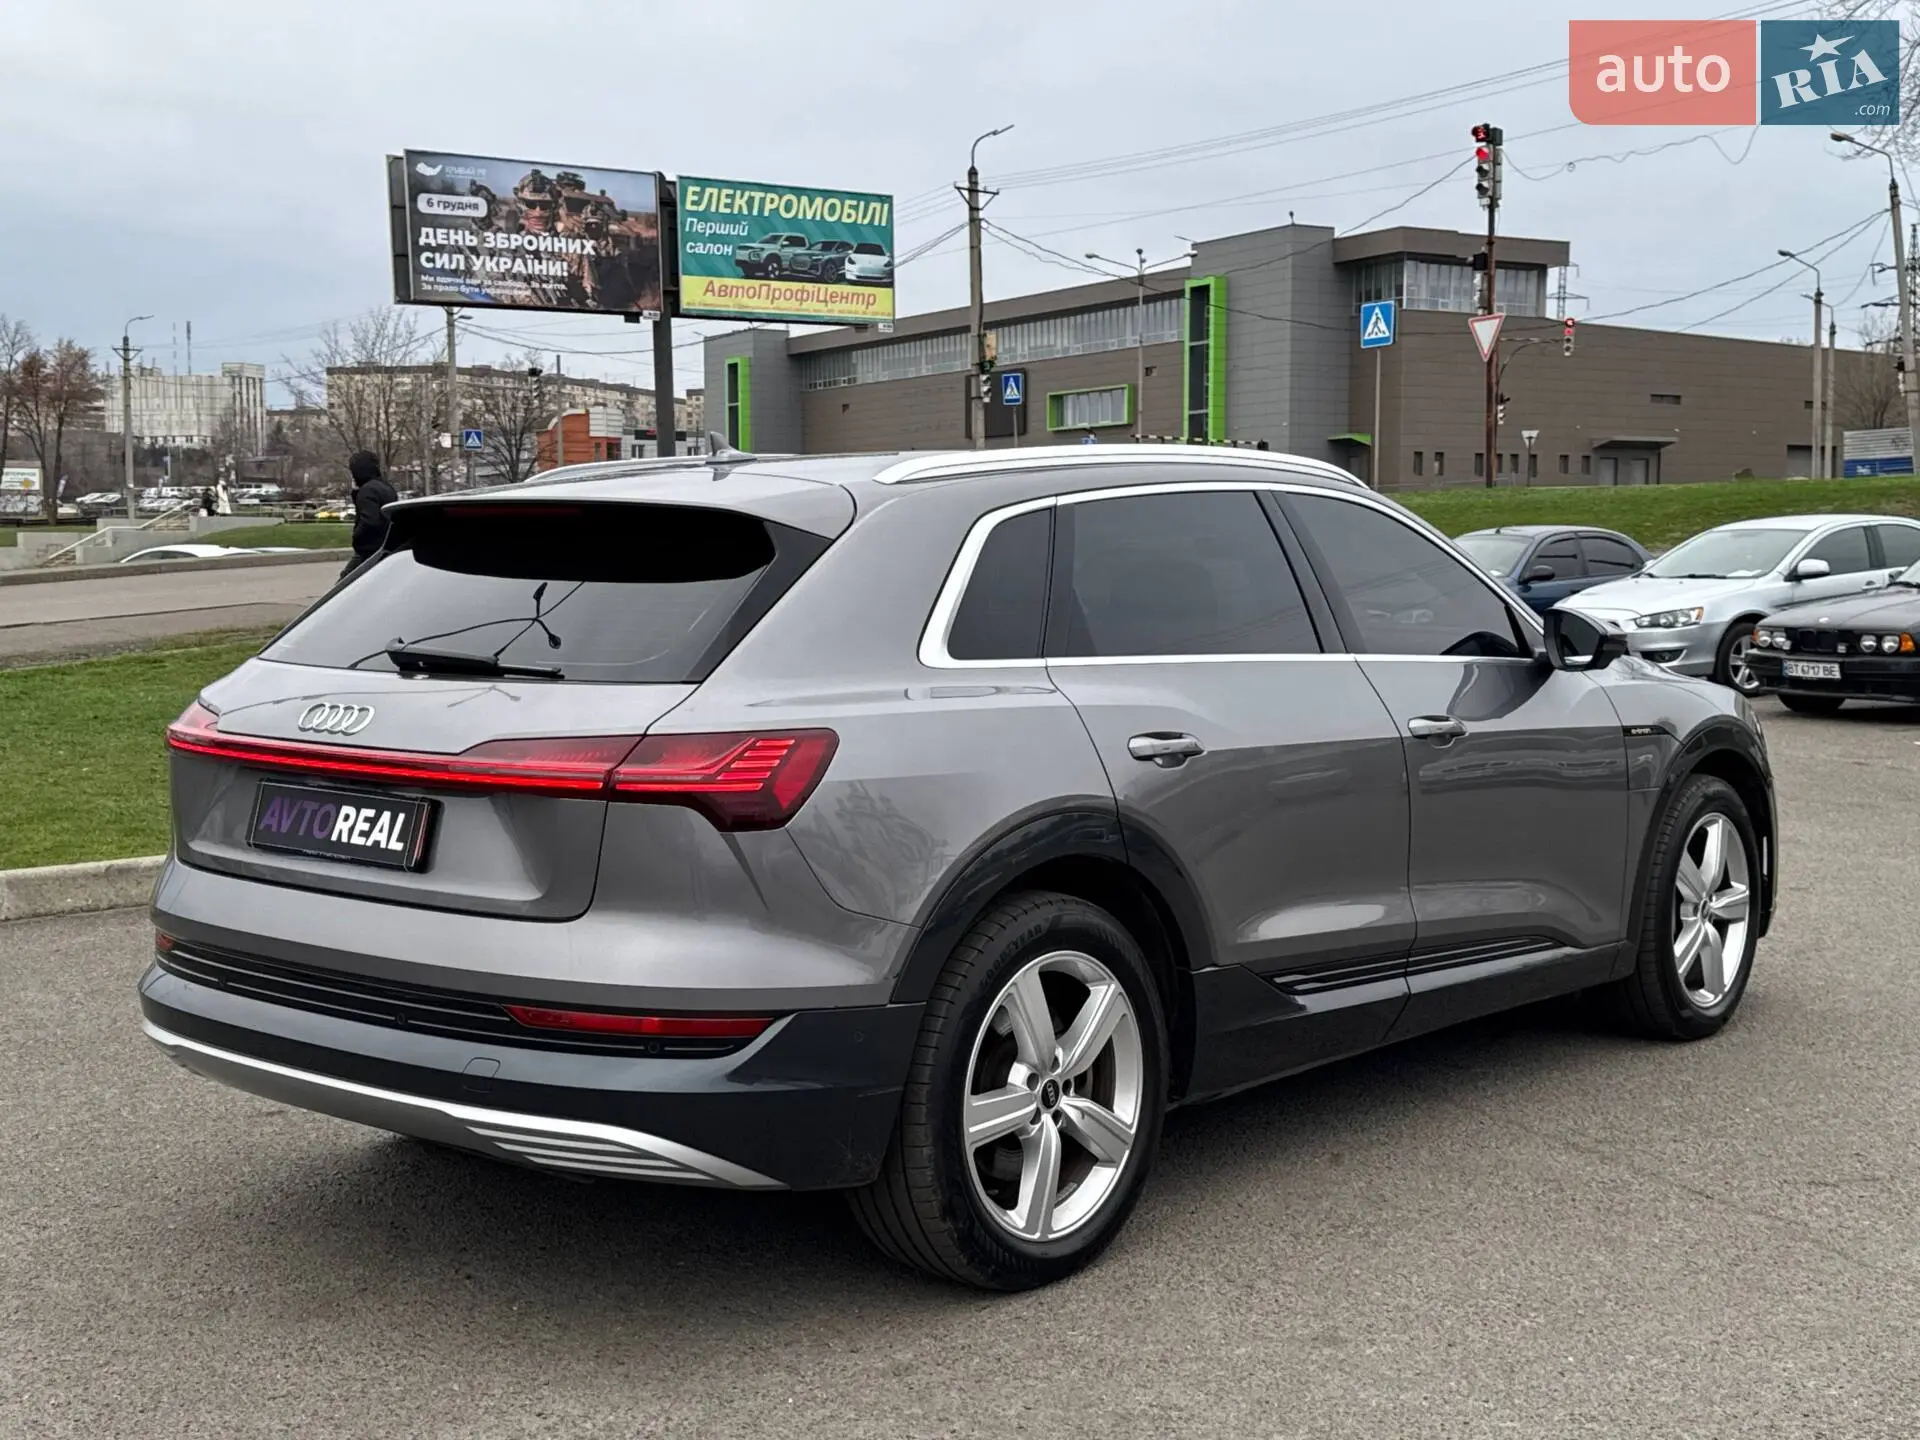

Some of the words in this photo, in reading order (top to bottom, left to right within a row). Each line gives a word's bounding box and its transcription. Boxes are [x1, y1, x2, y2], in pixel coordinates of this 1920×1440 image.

[426, 198, 434, 208] 6
[437, 200, 480, 212] грудня
[685, 186, 889, 227] ЕЛЕКТРОМОБІЛІ
[685, 217, 749, 237] Перший
[418, 227, 478, 247] ДЕНЬ
[483, 232, 597, 255] ЗБРОЙНИХ
[686, 241, 733, 256] салон
[419, 252, 465, 270] СИЛ
[470, 254, 569, 277] УКРАЇНИ!
[703, 280, 877, 310] АвтоПрофіЦентр
